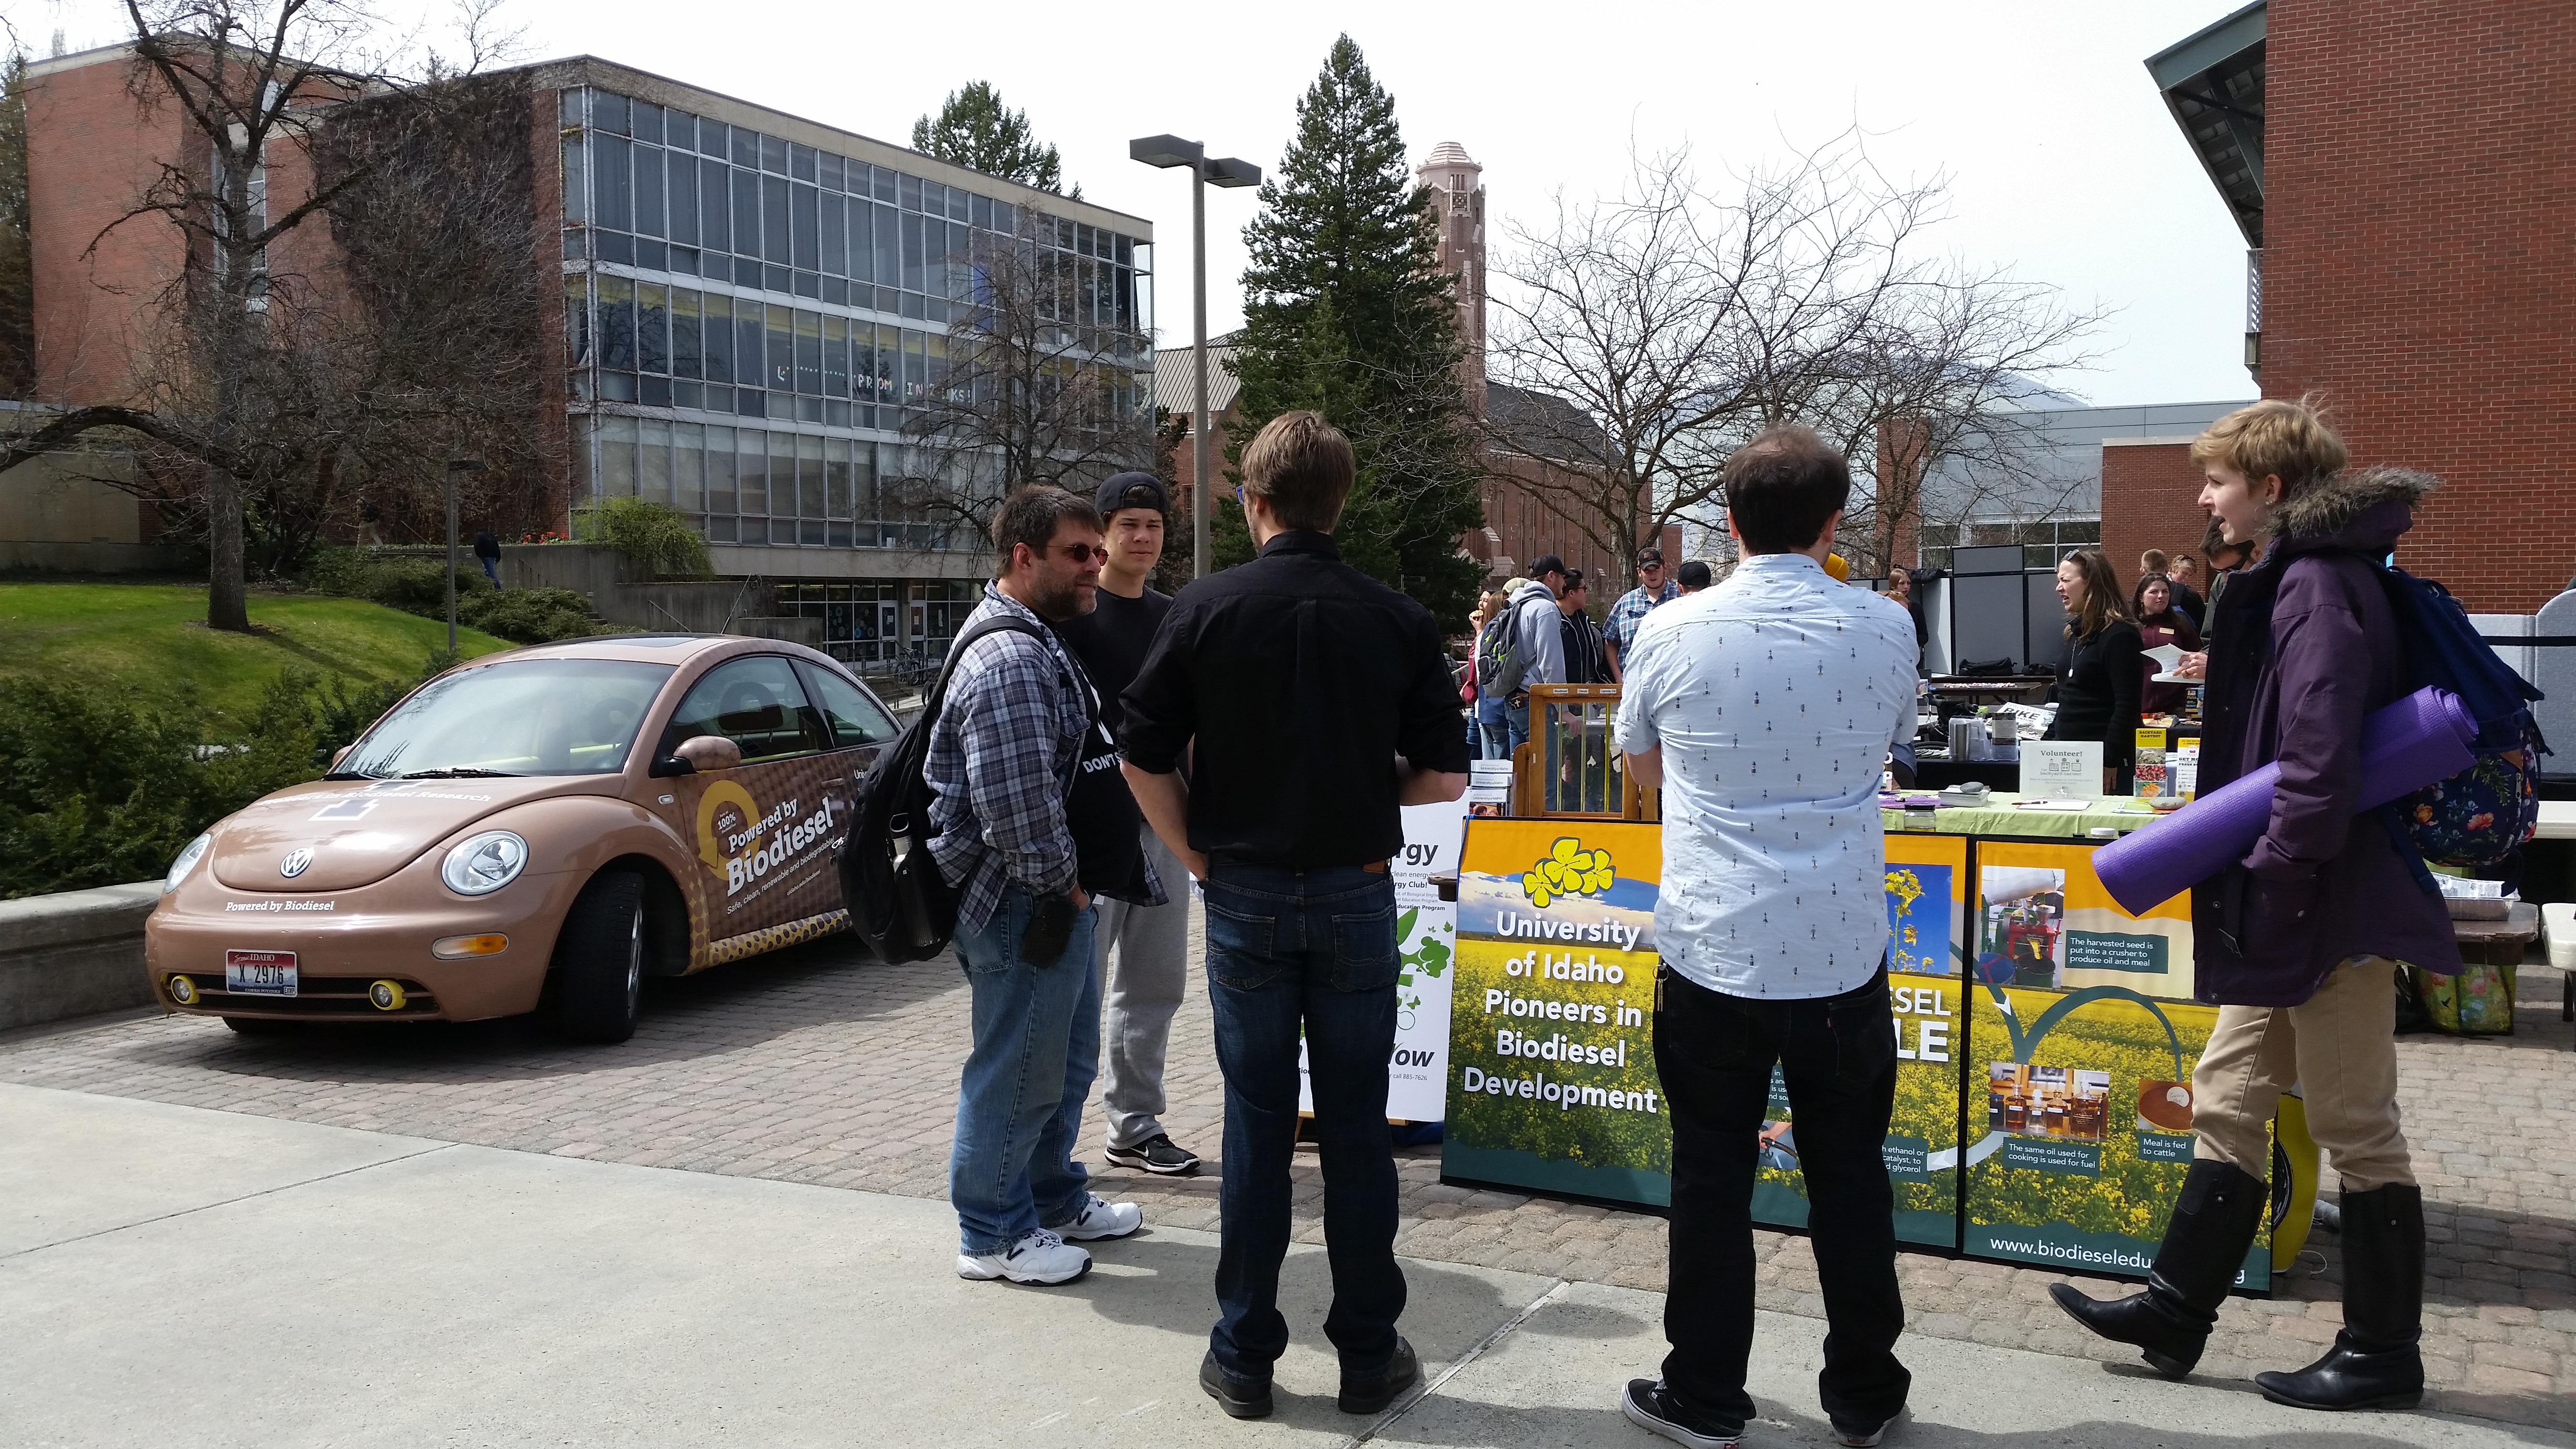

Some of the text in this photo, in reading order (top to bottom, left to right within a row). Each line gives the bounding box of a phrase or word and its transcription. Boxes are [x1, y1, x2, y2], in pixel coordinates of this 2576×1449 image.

[858, 373, 892, 391] PROM
[1082, 753, 1116, 773] DON'T
[415, 791, 491, 802] Research
[718, 812, 736, 830] 100%
[728, 798, 797, 853] Powered by
[726, 796, 834, 897] Biodiesel
[727, 835, 835, 915] Safe, clean, renewable and biodegradable!
[787, 869, 821, 896] uidaho.edu/biodiesel
[1409, 871, 1433, 880] energy
[225, 901, 335, 913] Powered by Biodiesel
[1497, 911, 1641, 951] University
[2087, 938, 2125, 948] harvested
[2070, 955, 2102, 964] produce
[2109, 949, 2137, 957] crusher
[239, 964, 284, 984] X 2976
[1506, 950, 1624, 984] of Idaho
[1485, 988, 1642, 1027] Pioneers in
[1497, 1030, 1625, 1067] Biodiesel
[1464, 1066, 1658, 1113] Development
[1888, 1146, 1915, 1155] ethanol
[2009, 1143, 2023, 1151] The
[2077, 1150, 2089, 1159] for
[2143, 1138, 2187, 1149] Meal is fed
[2008, 1153, 2038, 1163] cooking
[2081, 1160, 2095, 1168] fuel
[2153, 1149, 2176, 1158] cattle
[1892, 1163, 1920, 1173] glycerol
[1990, 1237, 2155, 1269] www.biodieseledu
